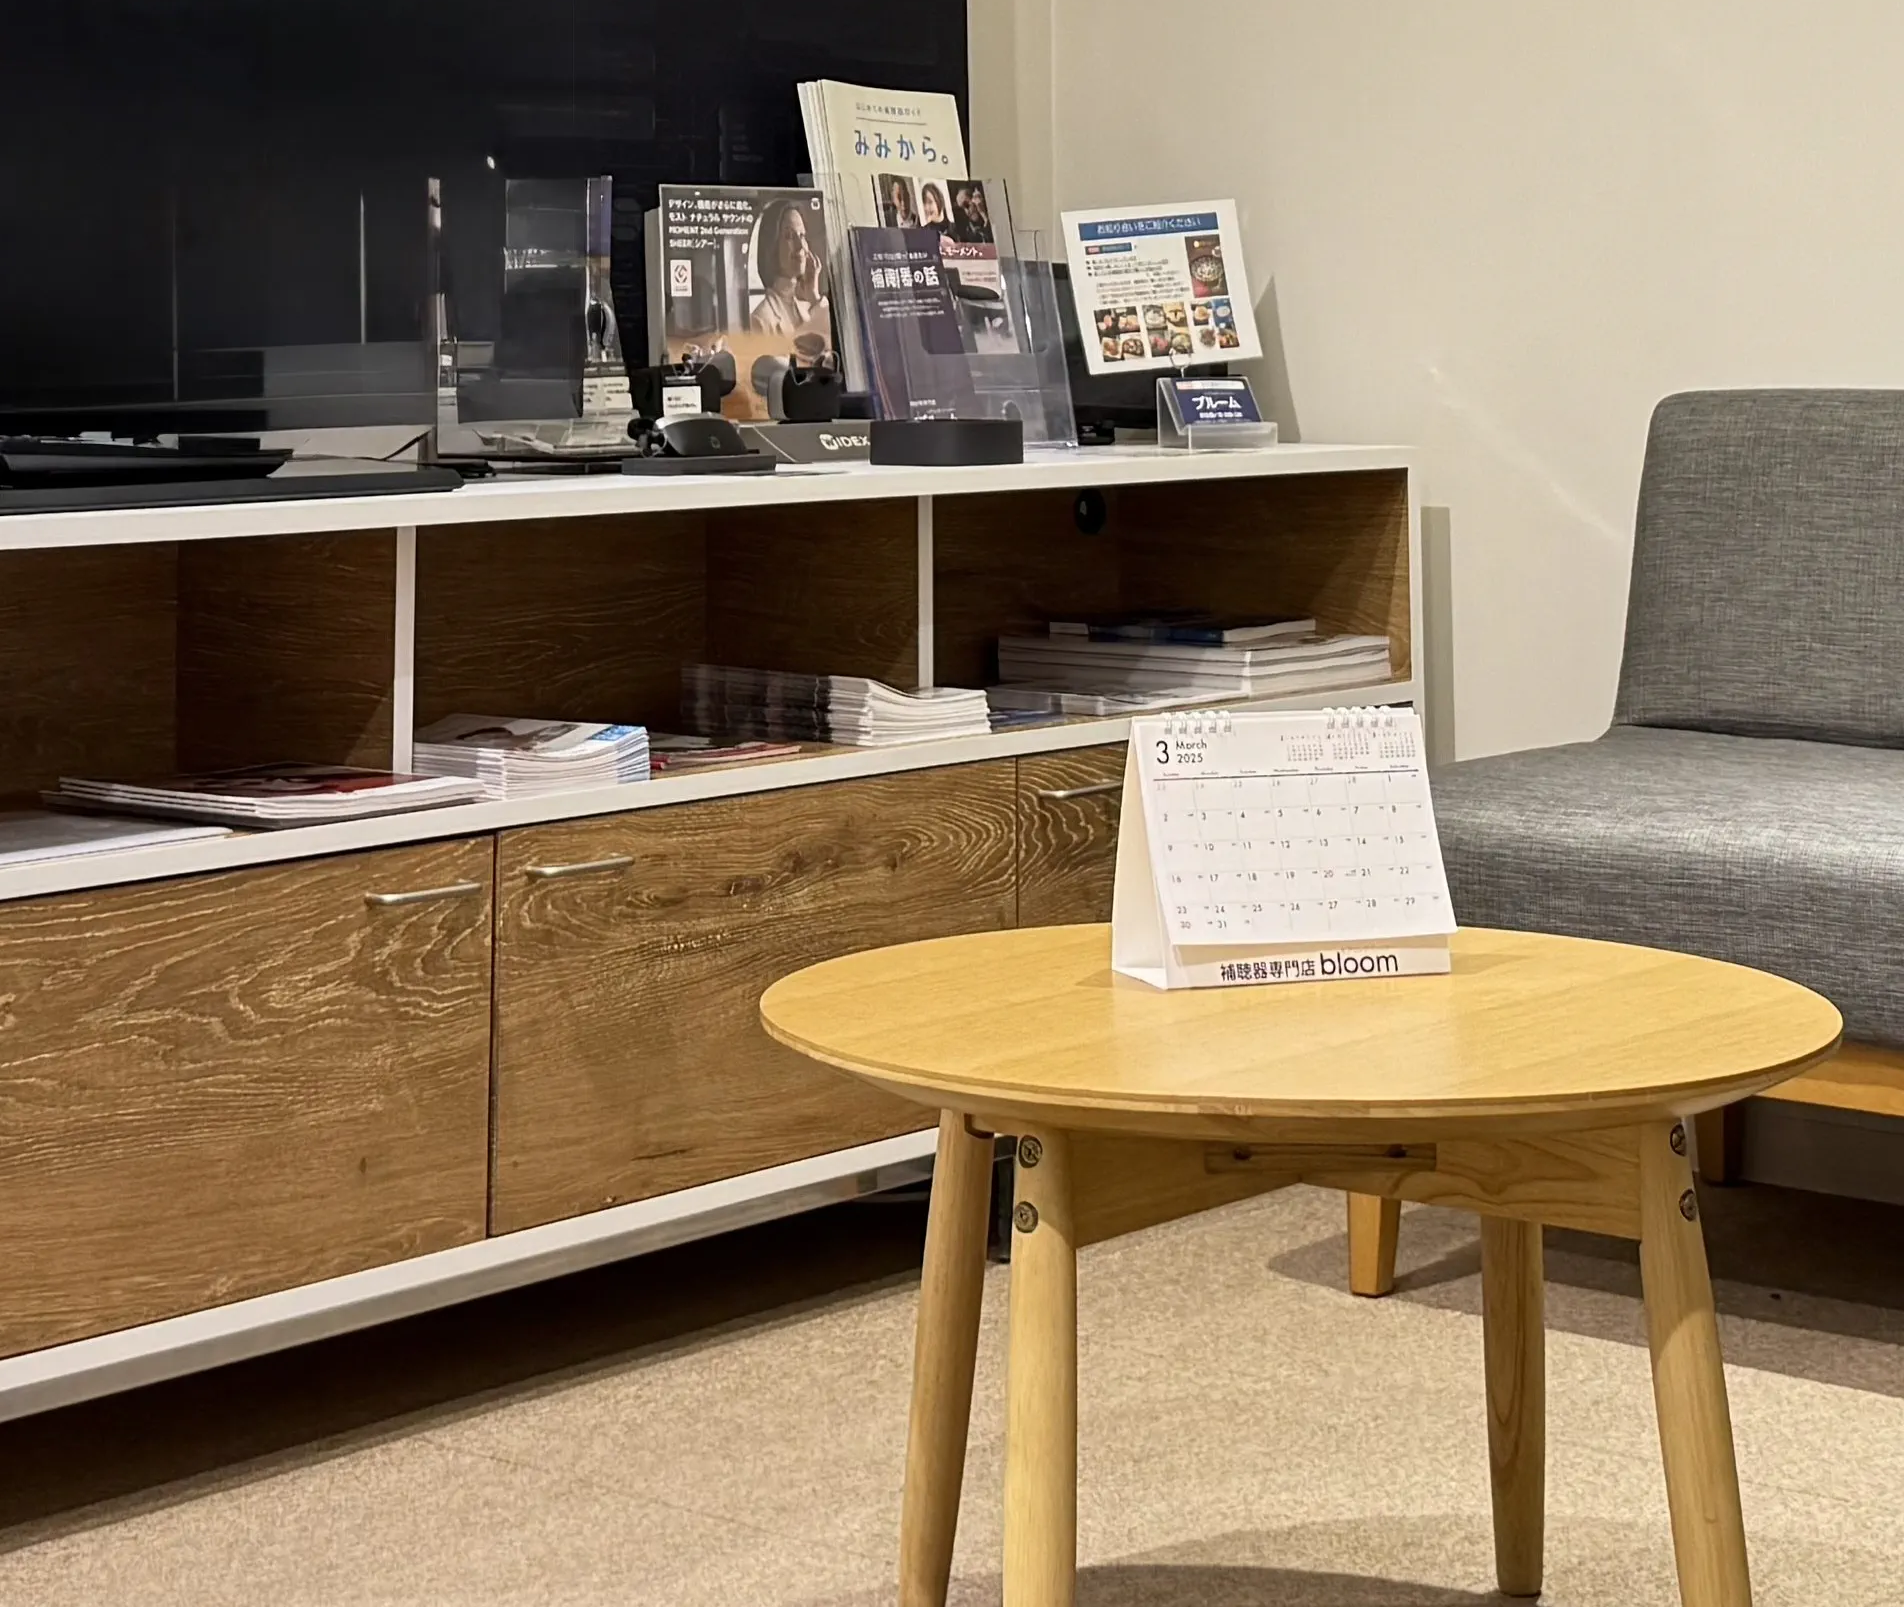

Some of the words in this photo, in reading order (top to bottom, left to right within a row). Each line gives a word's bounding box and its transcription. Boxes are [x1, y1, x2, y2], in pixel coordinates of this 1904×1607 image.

[854, 129, 949, 165] みみから。
[1192, 395, 1242, 410] ブルーム
[1156, 740, 1170, 765] 3
[1176, 738, 1208, 750] March
[1177, 753, 1203, 764] 2025
[1204, 843, 1214, 851] 10
[1243, 841, 1252, 849] 11
[1280, 840, 1290, 849] 12
[1357, 837, 1366, 845] 14
[1210, 873, 1219, 882] 17
[1323, 869, 1334, 878] 20
[1361, 868, 1371, 877] 21
[1399, 866, 1410, 875] 22
[1176, 905, 1187, 914] 23
[1215, 905, 1225, 914] 24
[1252, 903, 1263, 912] 25
[1328, 900, 1338, 910] 27
[1366, 898, 1377, 908] 28
[1405, 896, 1415, 906] 29
[1217, 919, 1227, 929] 31
[1220, 959, 1316, 982] 補聴器専門店
[1319, 951, 1399, 976] bloom
